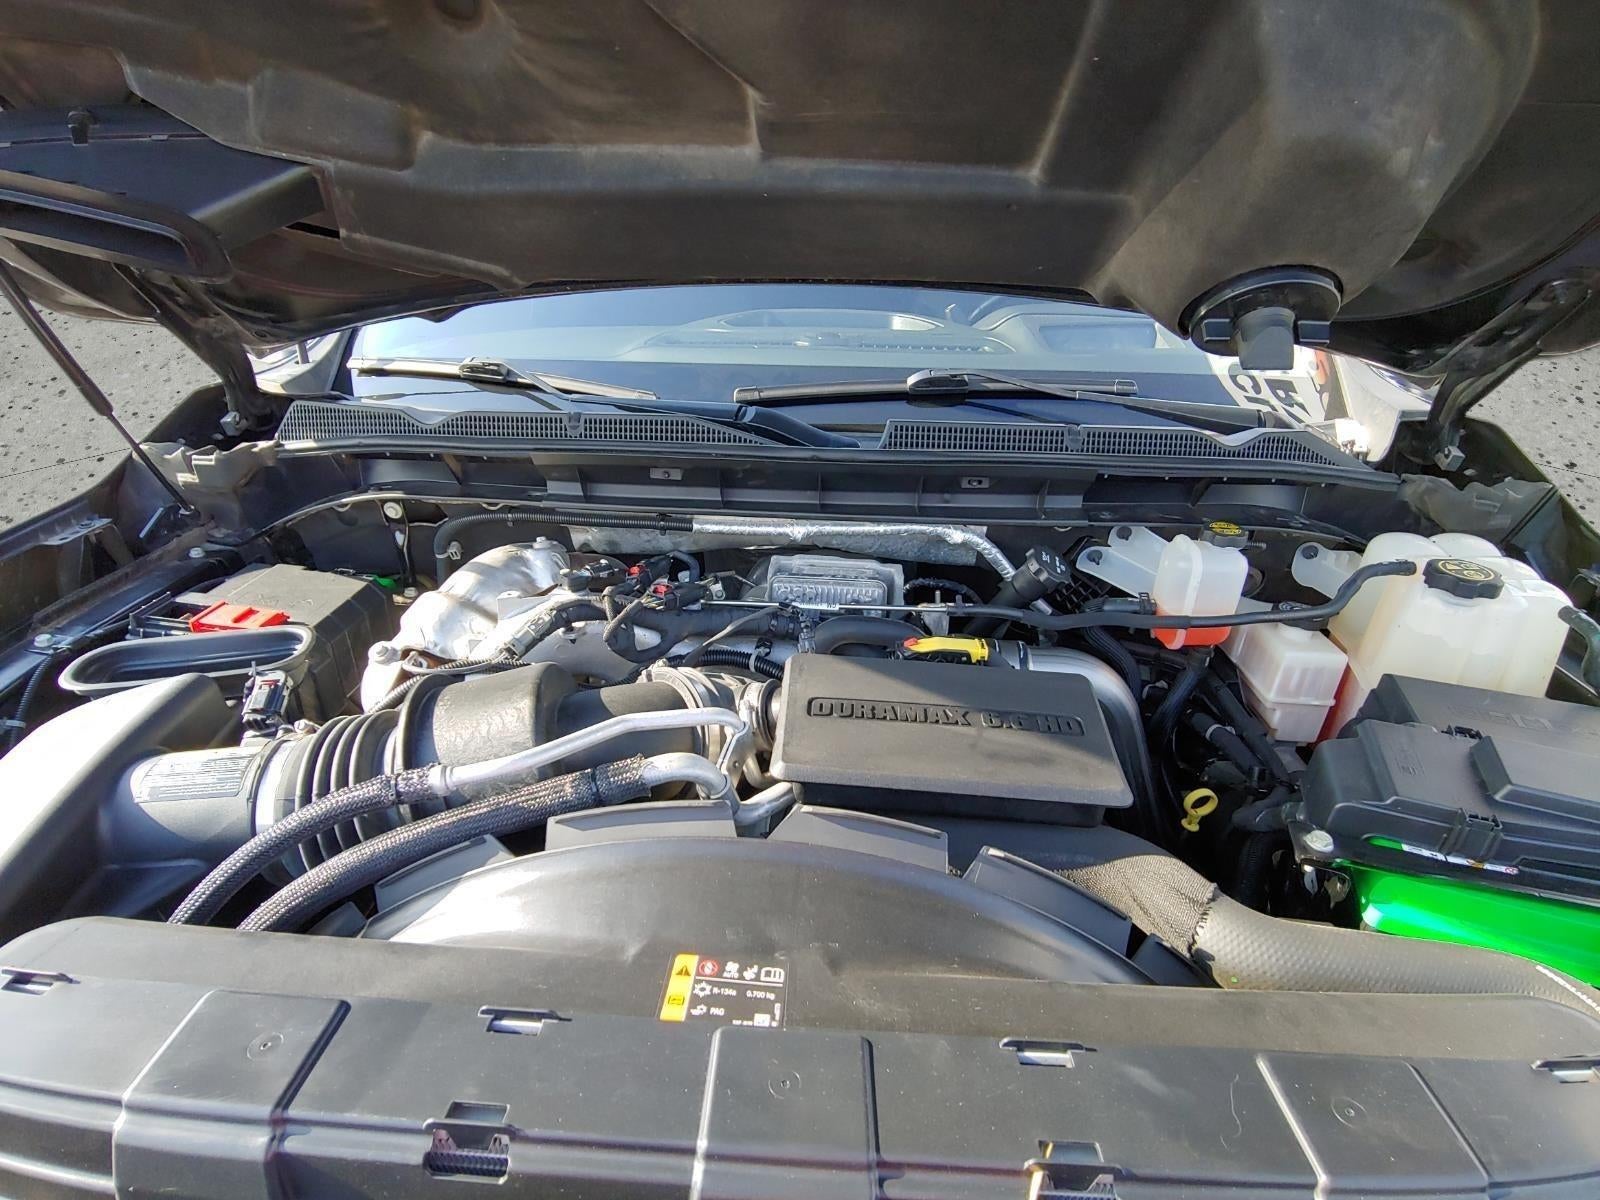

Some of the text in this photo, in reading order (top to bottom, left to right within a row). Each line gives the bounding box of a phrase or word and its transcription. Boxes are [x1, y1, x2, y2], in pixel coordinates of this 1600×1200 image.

[810, 699, 1084, 735] DURAMAX 6.6 HD
[712, 987, 775, 1000] R-134a 0.700 kg
